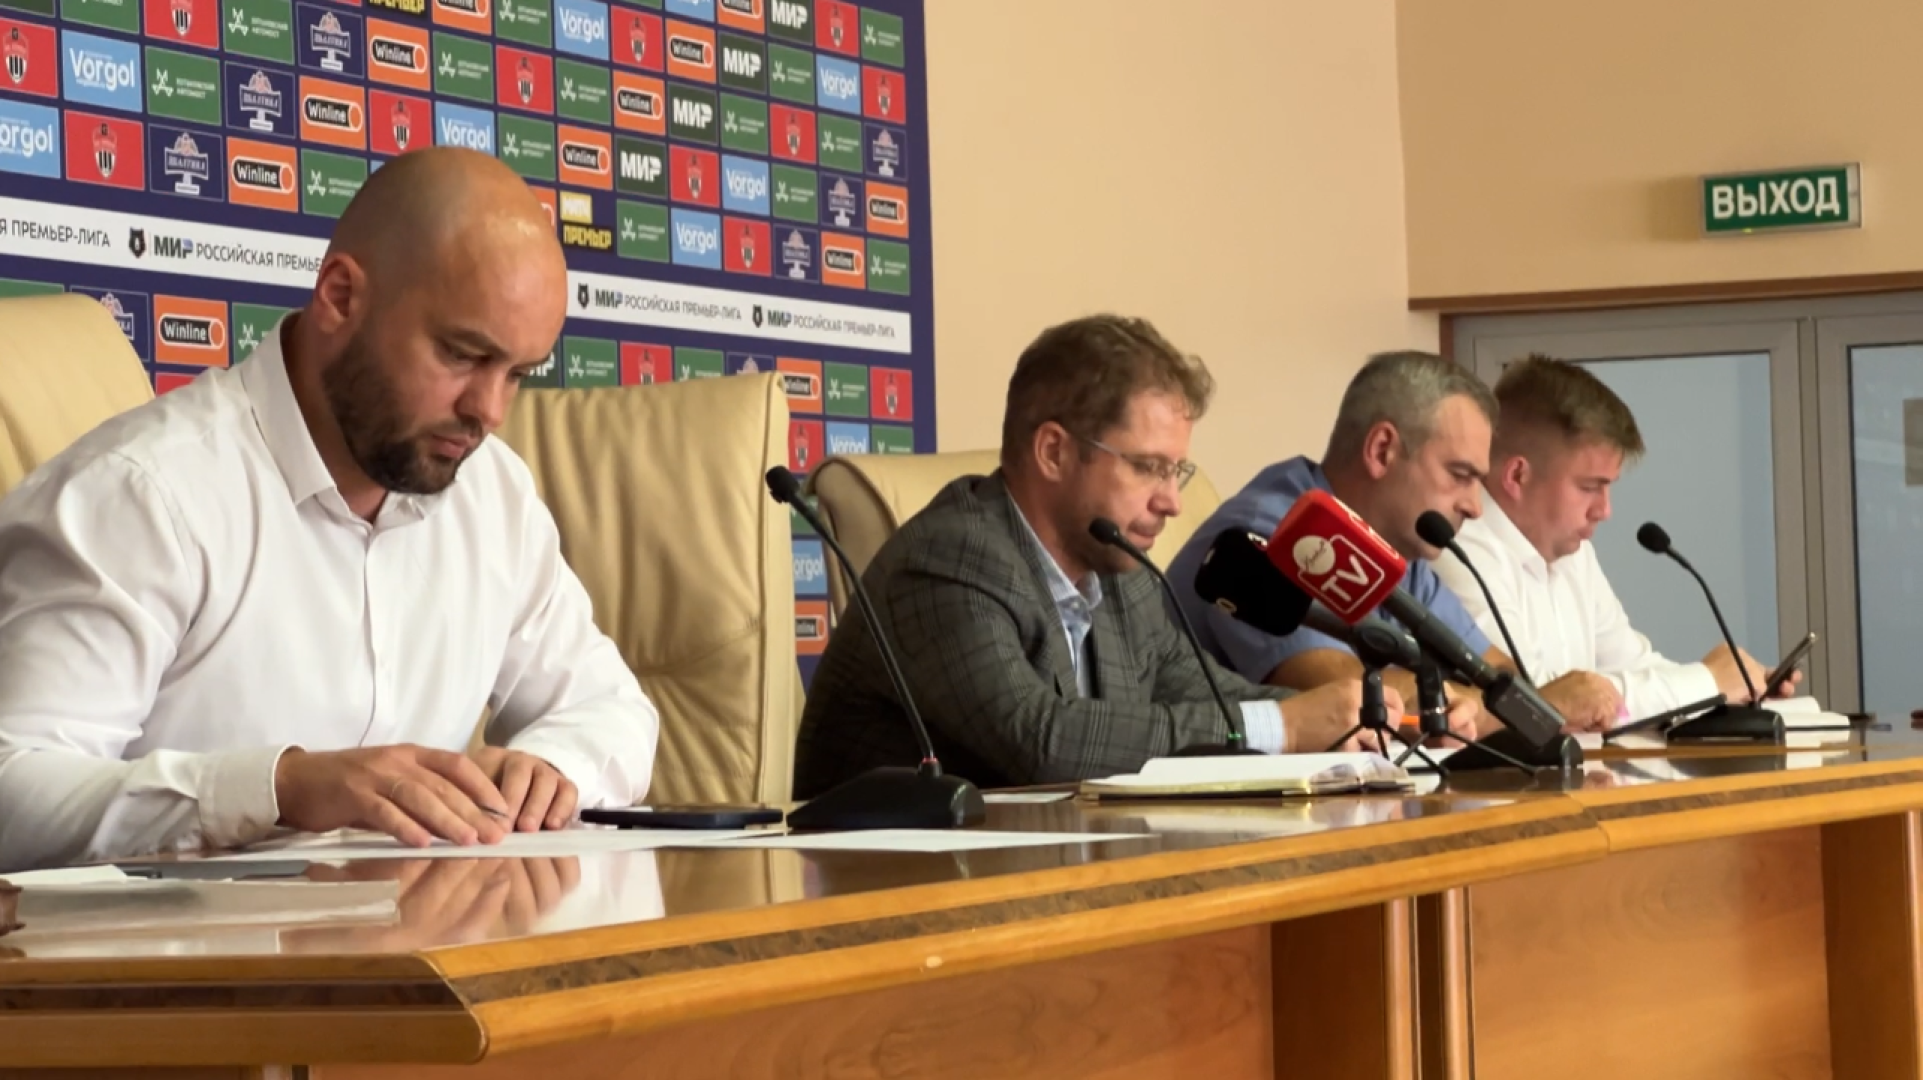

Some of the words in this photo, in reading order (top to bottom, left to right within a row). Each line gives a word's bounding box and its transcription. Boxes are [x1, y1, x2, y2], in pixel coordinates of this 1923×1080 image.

[560, 6, 605, 43] Vorgol
[771, 0, 807, 28] МИР
[375, 43, 411, 64] Winline
[723, 47, 761, 78] МИР
[69, 48, 135, 92] Vorgol
[820, 68, 857, 99] Vorgol
[307, 102, 346, 122] Winline
[673, 98, 713, 129] МИР
[0, 123, 53, 157] orgol
[441, 116, 490, 150] Vorgol
[565, 147, 597, 167] Winline
[620, 151, 662, 183] МИР
[236, 162, 278, 185] Winline
[727, 169, 766, 200] Vorgol
[1712, 176, 1841, 219] ВЫХОД
[11, 219, 110, 247] ПРЕМЬЕР-ЛИГА
[676, 221, 717, 254] Vorgol
[154, 235, 194, 259] МИР
[196, 243, 274, 267] РОССИЙСКАЯ
[276, 253, 321, 272] ПРЕМЬЕ
[595, 289, 623, 309] МИР
[163, 321, 208, 342] Winline
[767, 309, 792, 328] МИР
[793, 553, 825, 582] orgol
[1321, 554, 1369, 602] TV
